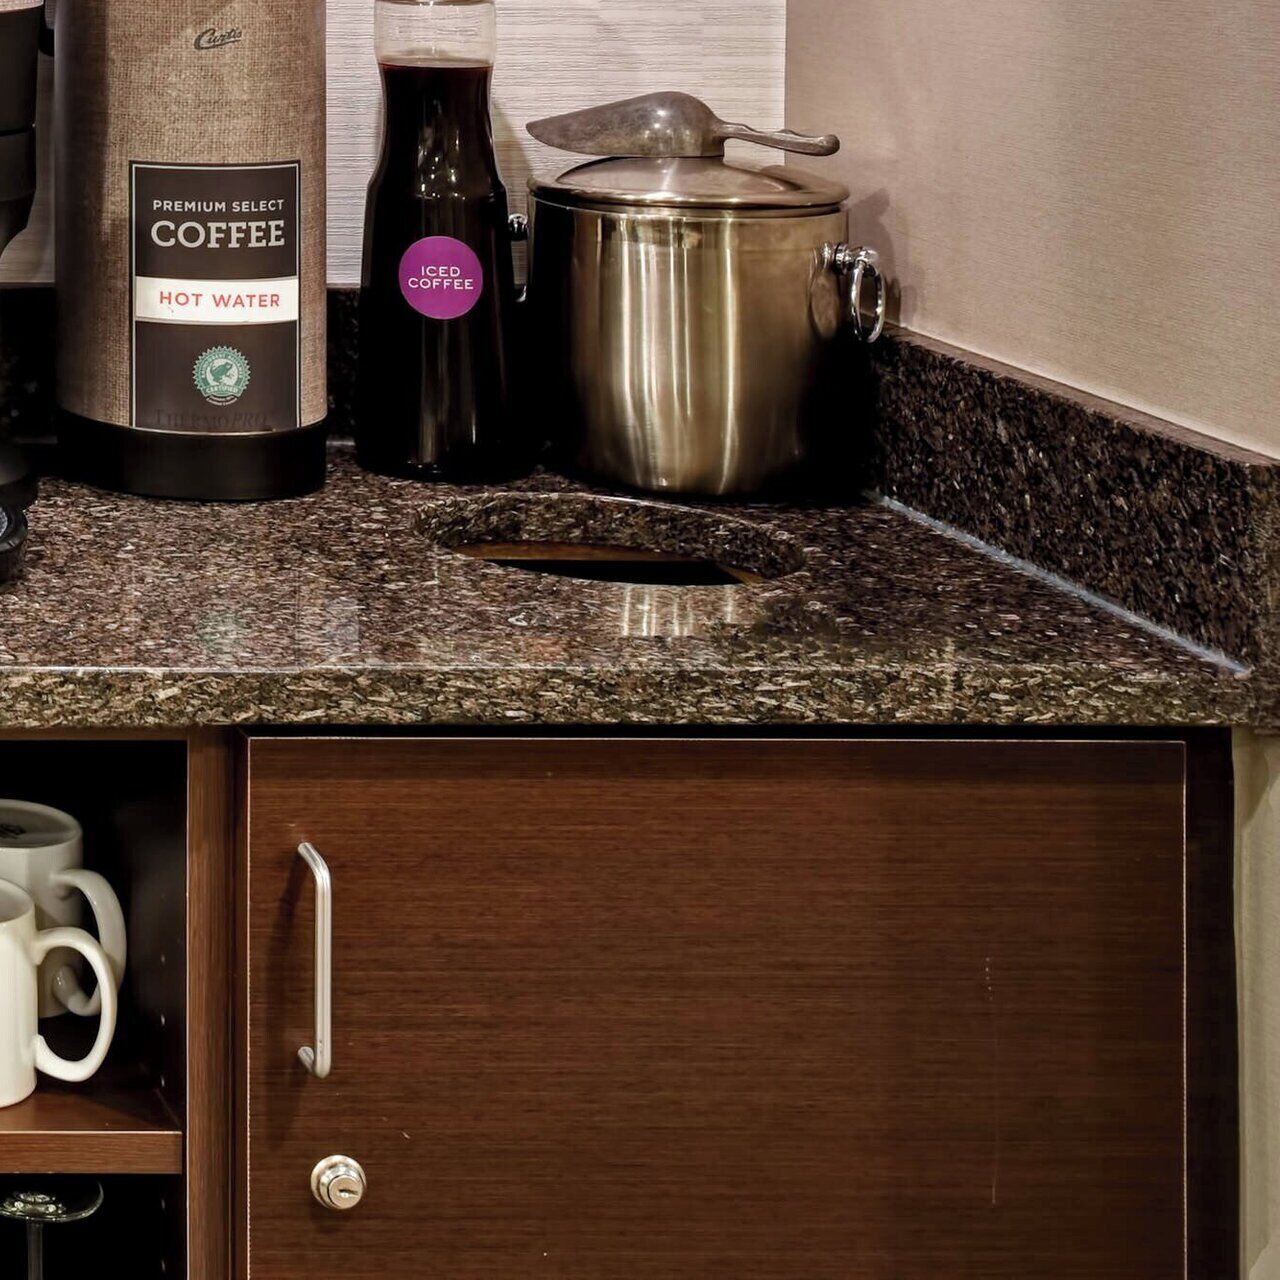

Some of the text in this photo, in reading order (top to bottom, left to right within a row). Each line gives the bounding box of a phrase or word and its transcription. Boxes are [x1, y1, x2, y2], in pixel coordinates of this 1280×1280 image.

[194, 28, 242, 50] Curtis
[153, 199, 284, 212] PREMIUM SELECT
[151, 220, 285, 248] COFFEE
[421, 266, 461, 277] ICED
[407, 277, 474, 290] COFFEE
[159, 291, 280, 308] HOT WATER
